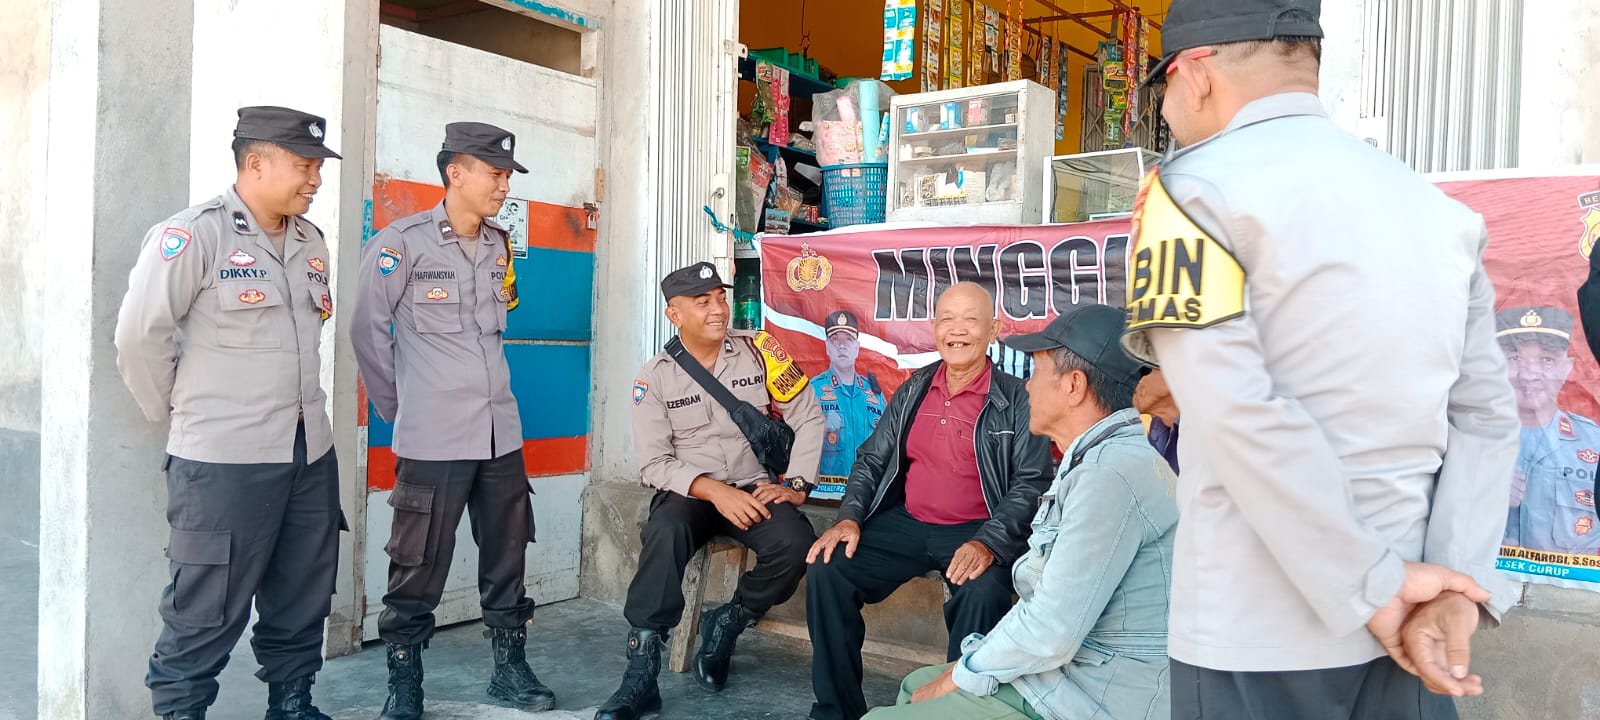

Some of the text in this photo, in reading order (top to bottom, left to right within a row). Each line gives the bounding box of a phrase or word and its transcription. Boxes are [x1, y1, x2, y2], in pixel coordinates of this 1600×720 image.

[220, 268, 267, 280] DIKKY.P
[731, 374, 764, 388] POLRI
[1528, 563, 1570, 577] CURUP
